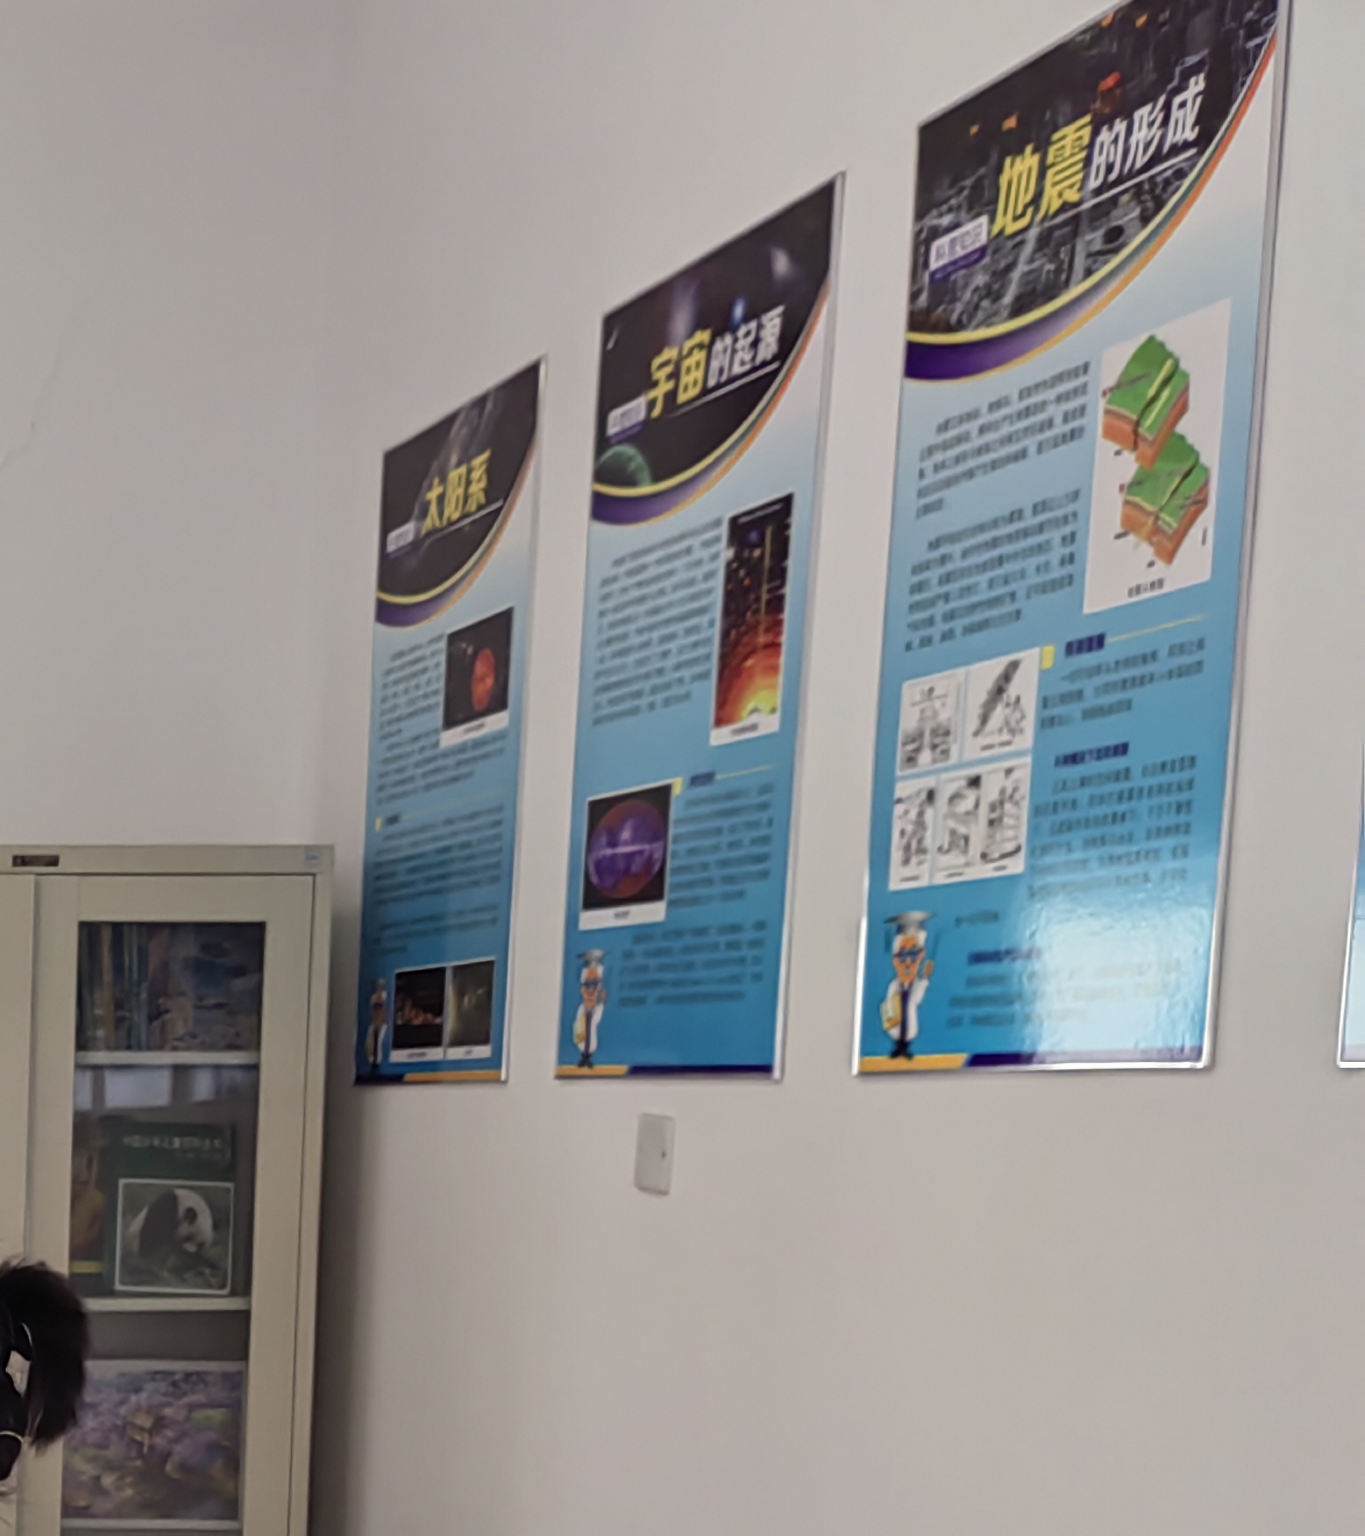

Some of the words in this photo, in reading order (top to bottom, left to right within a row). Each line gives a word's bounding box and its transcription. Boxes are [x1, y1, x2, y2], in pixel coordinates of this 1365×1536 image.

[991, 72, 1207, 239] 地震的形成
[646, 305, 786, 419] 宇宙的起源
[421, 448, 492, 537] 太阳系
